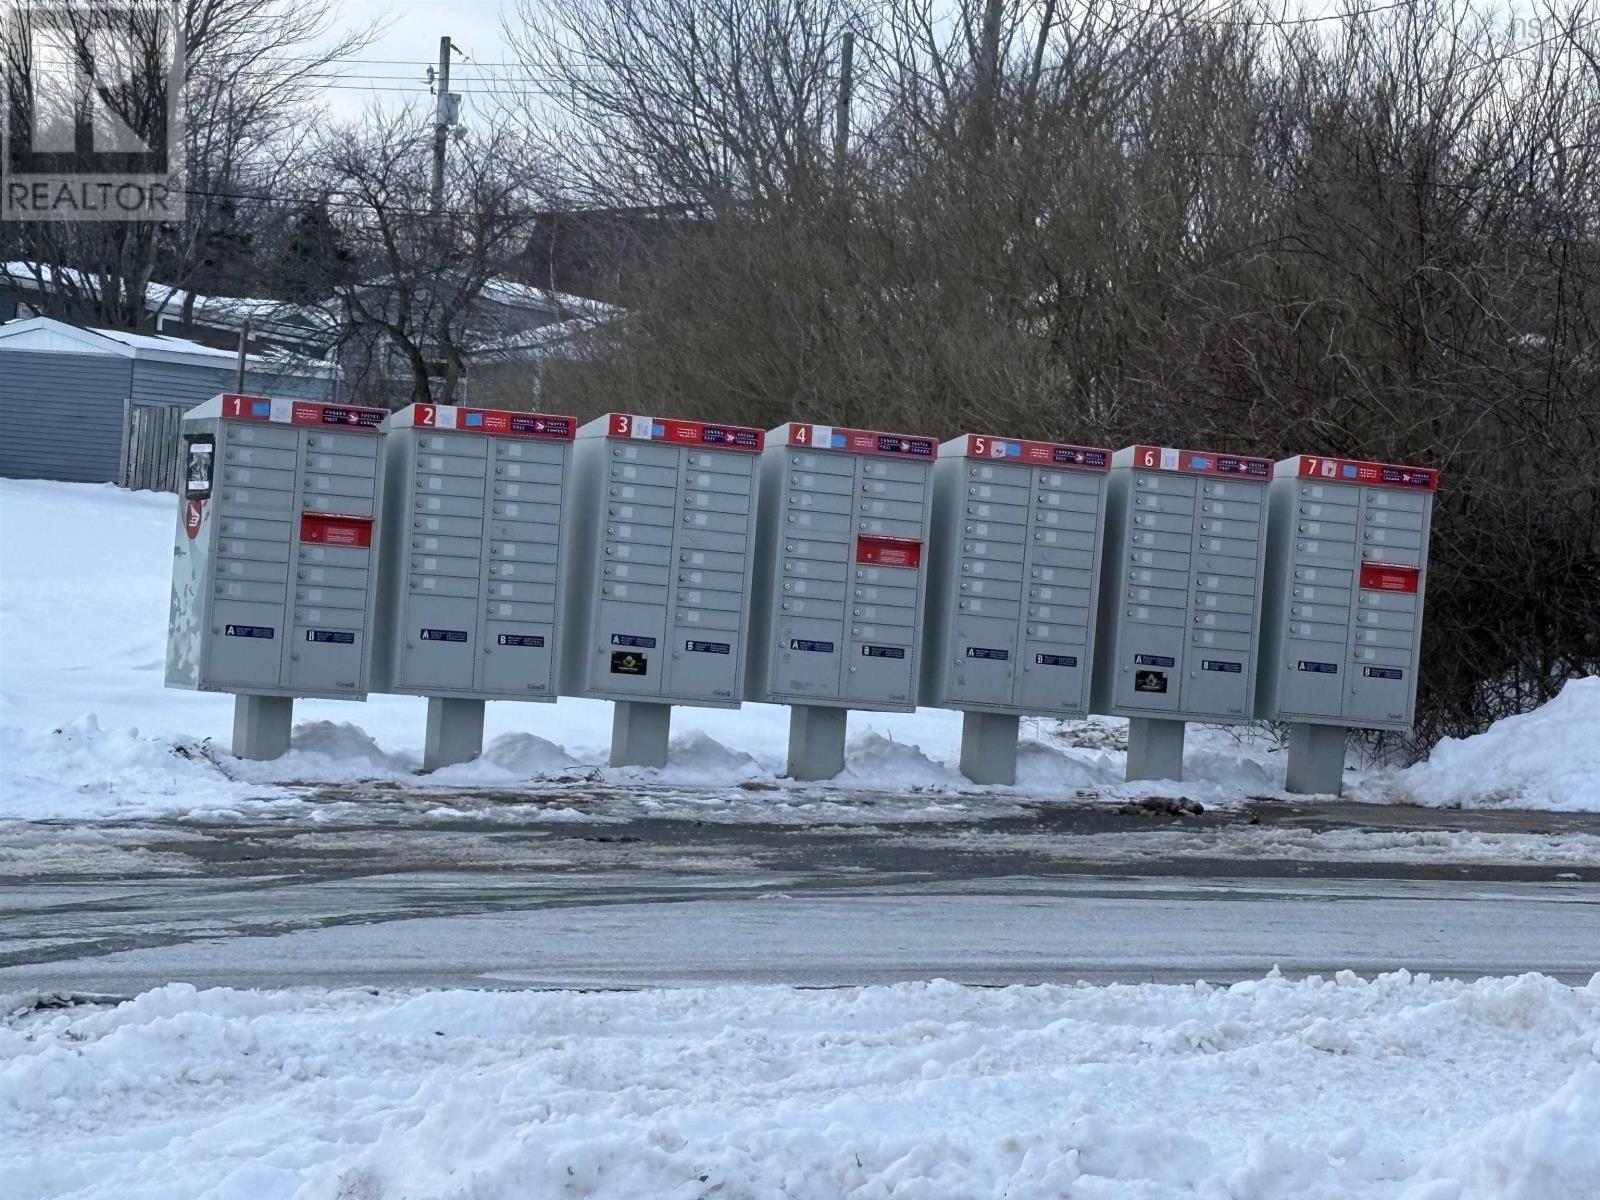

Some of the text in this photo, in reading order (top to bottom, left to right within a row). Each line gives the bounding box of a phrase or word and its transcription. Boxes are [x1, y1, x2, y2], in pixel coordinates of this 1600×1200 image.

[233, 398, 241, 416] 1
[423, 407, 433, 425] 2
[617, 416, 628, 433] 3
[796, 427, 806, 443] 4
[975, 438, 985, 454] 5
[1144, 451, 1154, 466] 6
[1308, 459, 1317, 475] 7
[227, 626, 235, 635] A
[422, 630, 429, 640] A
[500, 635, 506, 644] B
[613, 635, 619, 645] A
[687, 641, 694, 651] B
[792, 640, 799, 650] A
[968, 648, 975, 657] A
[1136, 655, 1142, 664] A
[1299, 661, 1305, 670] A
